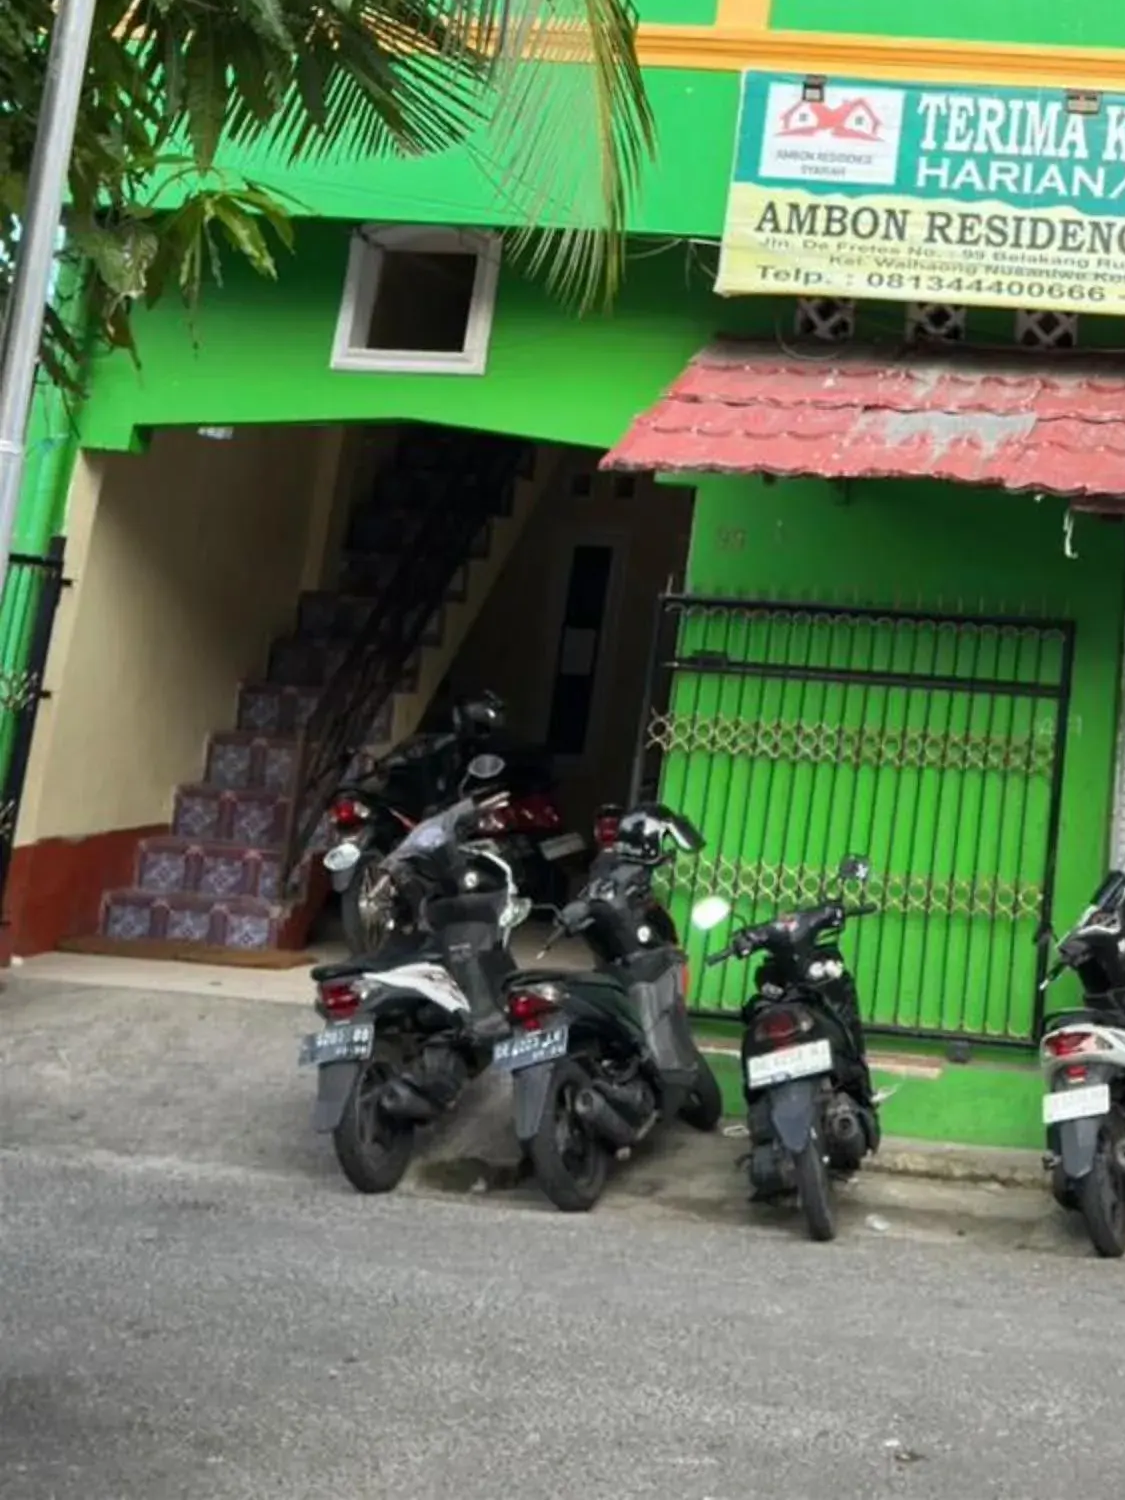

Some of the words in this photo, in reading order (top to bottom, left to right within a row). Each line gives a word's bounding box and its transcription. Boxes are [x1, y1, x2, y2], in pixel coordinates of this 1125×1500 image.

[917, 92, 1089, 160] TERIMA
[755, 200, 912, 242] AMBON
[756, 264, 833, 287] Telp.
[866, 271, 1106, 302] 081344400666
